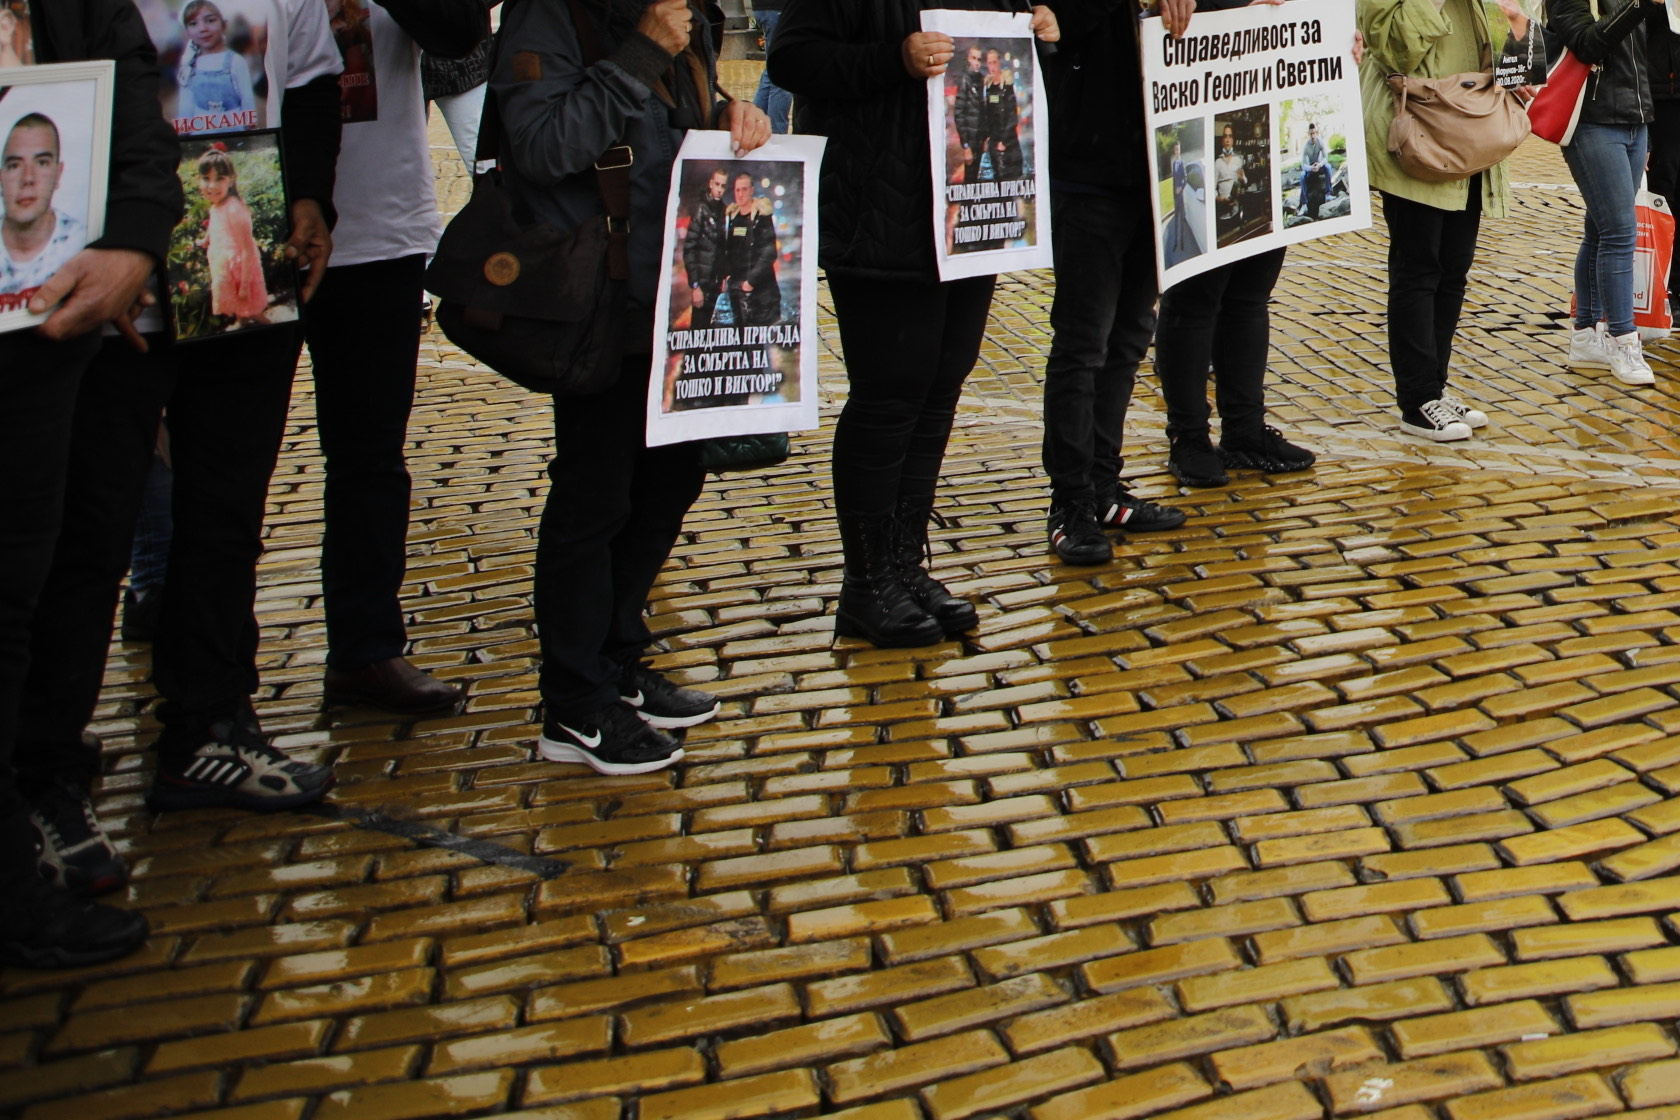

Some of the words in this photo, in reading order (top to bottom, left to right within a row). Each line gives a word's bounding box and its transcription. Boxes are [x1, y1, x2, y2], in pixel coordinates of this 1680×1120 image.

[1162, 21, 1298, 68] Справедливост
[1300, 19, 1322, 45] за
[1152, 78, 1199, 115] Васко
[1203, 68, 1259, 104] Георги
[1262, 66, 1272, 92] и
[1276, 55, 1343, 90] Светли
[173, 110, 257, 133] ИСКАМЕ
[1000, 179, 1035, 199] ПРИСЪДА
[960, 205, 969, 222] ЗА
[970, 202, 1005, 221] СМЪРТТА
[1006, 200, 1017, 217] НА
[954, 225, 982, 244] ТОШКО
[982, 224, 989, 241] И
[743, 325, 800, 348] ПРИСЪДА
[683, 354, 695, 374] ЗА
[698, 350, 749, 373] СМЪРТТА
[752, 350, 769, 369] НА
[675, 376, 712, 400] ТОШКО
[714, 376, 723, 395] И
